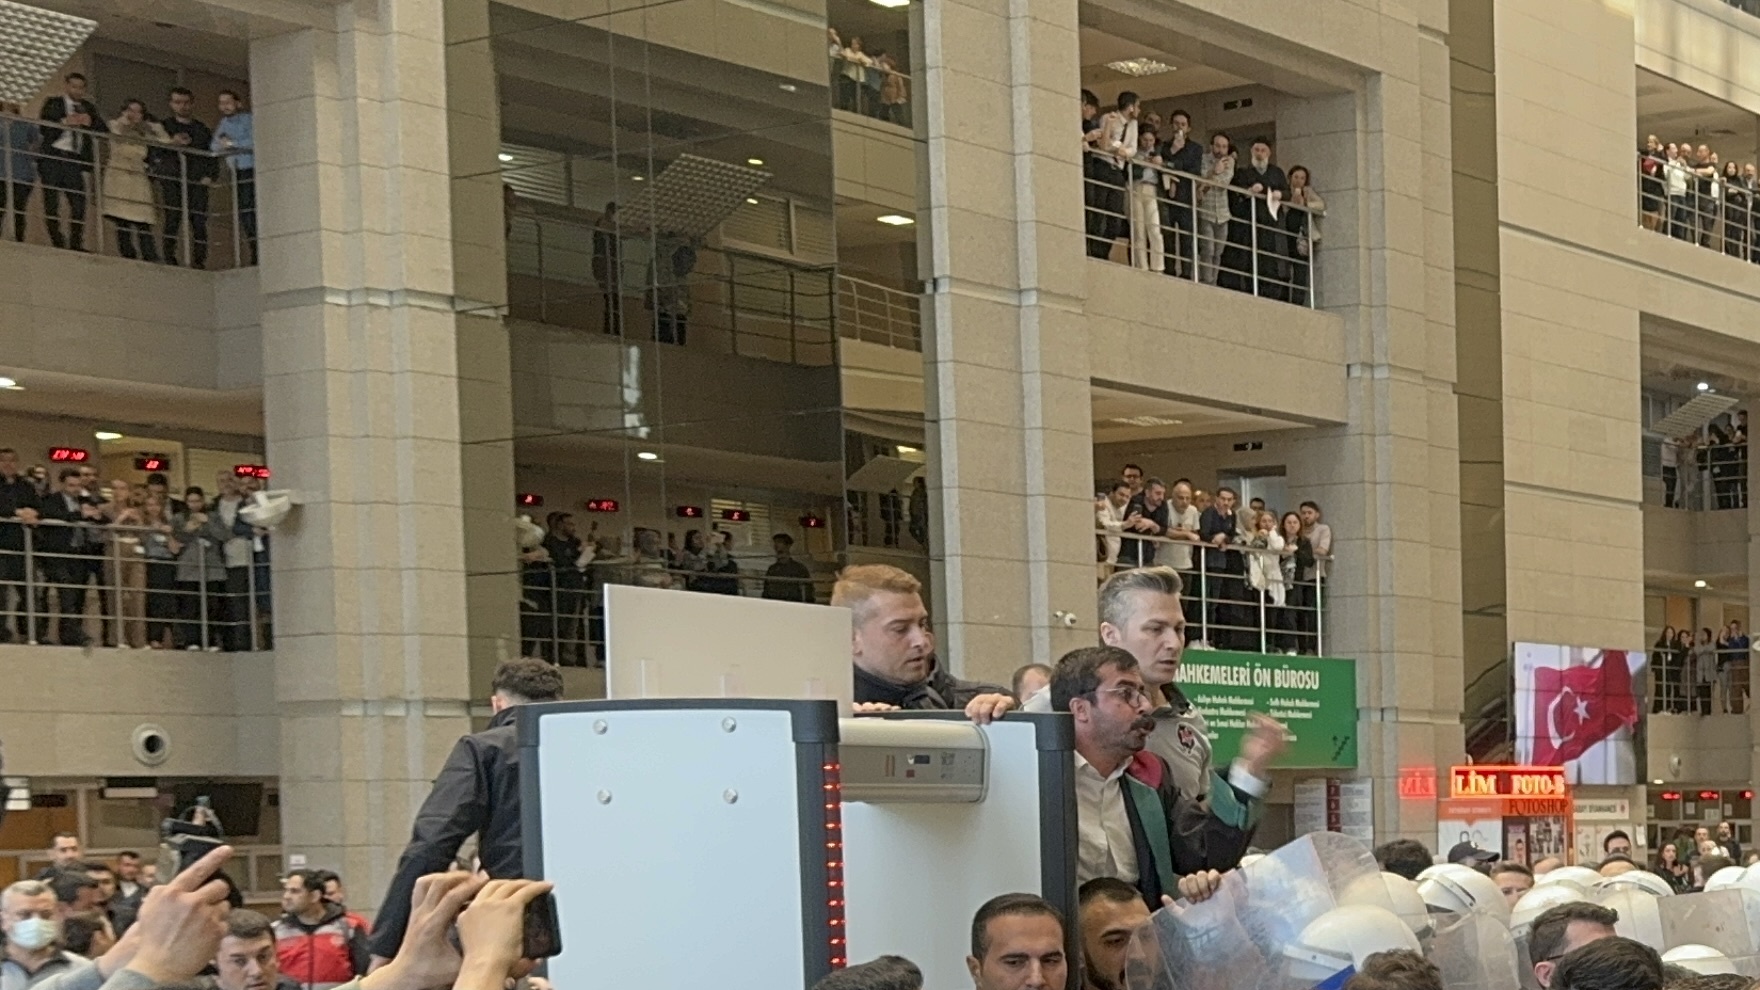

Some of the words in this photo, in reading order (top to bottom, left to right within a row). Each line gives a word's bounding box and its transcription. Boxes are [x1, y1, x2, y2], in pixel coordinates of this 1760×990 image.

[1253, 662, 1271, 687] ÖN
[1274, 664, 1319, 690] BÜROSU
[1509, 799, 1568, 815] FOTOSHOP
